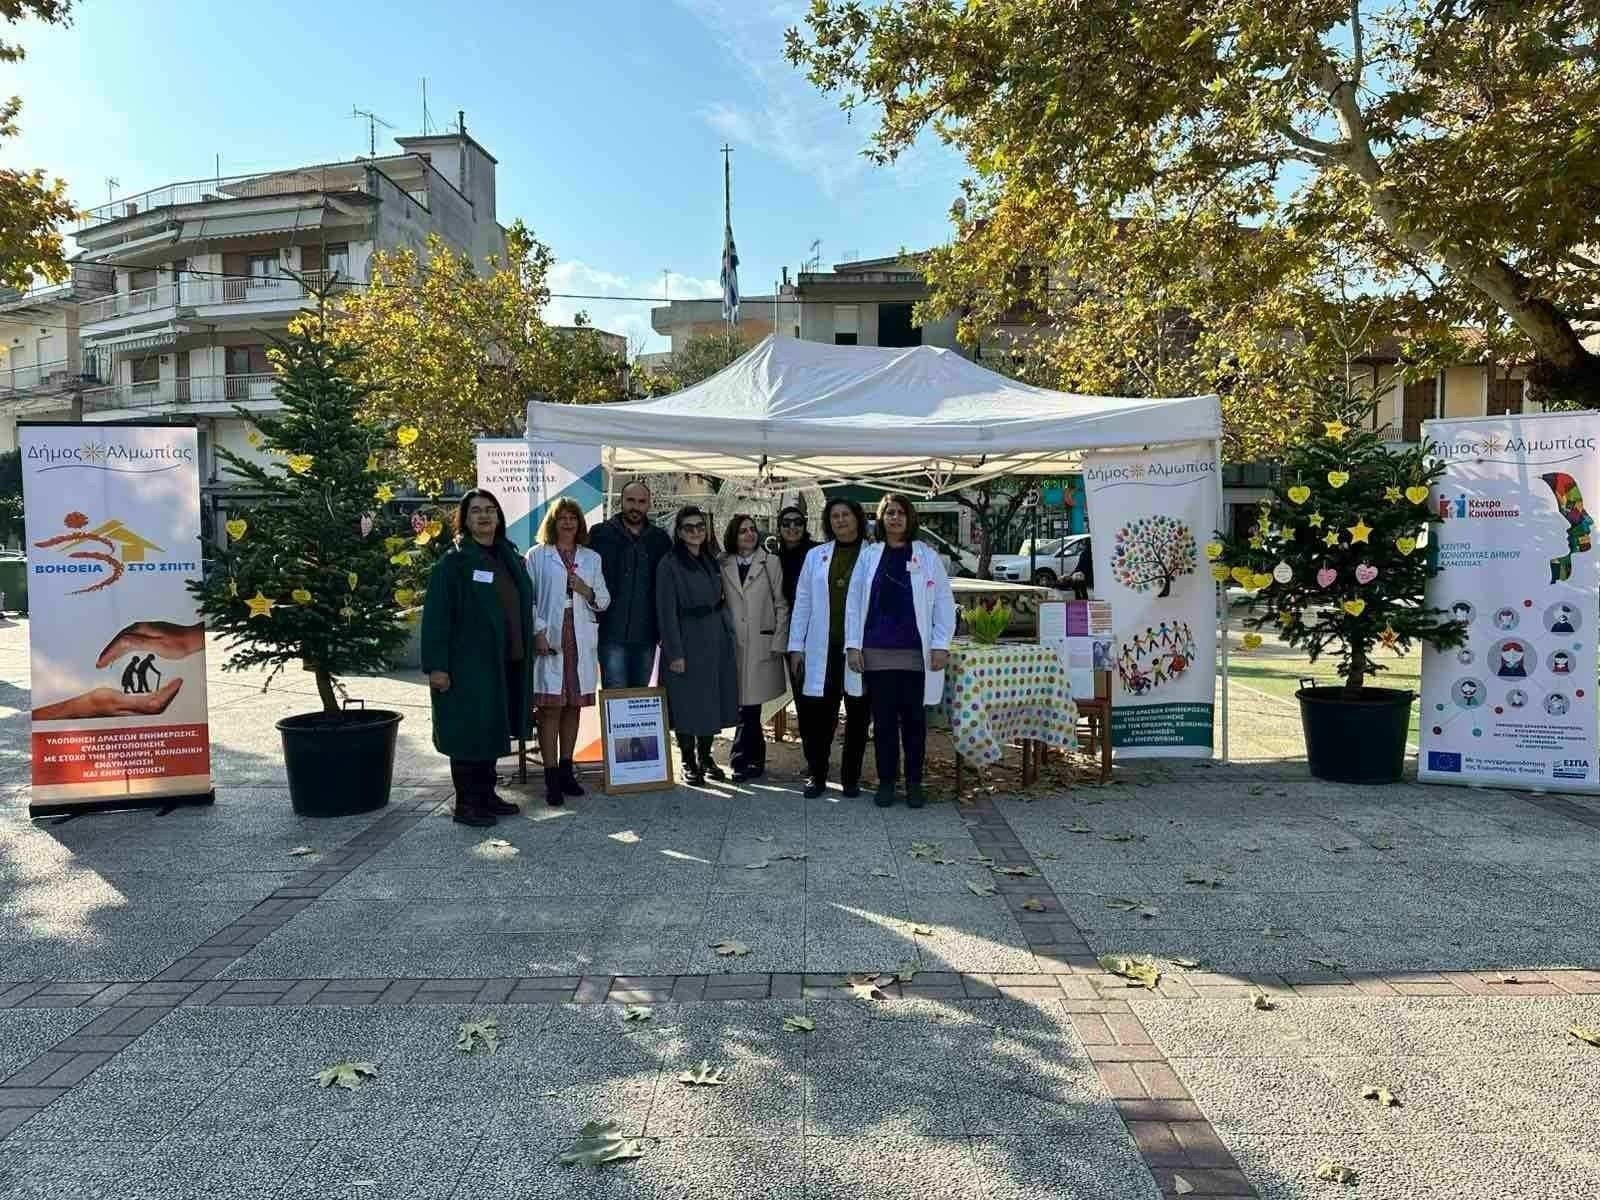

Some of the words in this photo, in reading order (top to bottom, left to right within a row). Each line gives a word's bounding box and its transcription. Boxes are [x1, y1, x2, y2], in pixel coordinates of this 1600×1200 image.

[1504, 434, 1597, 454] Αλμωπίας
[27, 443, 83, 462] Δήμος
[105, 443, 193, 462] Αλμωπίας
[485, 475, 522, 483] ΚΕΝΤΡΟ
[1468, 498, 1501, 509] Κέντρο
[1468, 509, 1520, 518] Κοινότητας
[34, 563, 103, 574] ΒΟΗΘΕΙΑ
[127, 563, 156, 572] ΣΤΟ
[159, 562, 196, 571] ΣΠΙΤΙ
[47, 735, 96, 745] ΥΛΟΠΟΙΗΣΗ
[97, 733, 137, 743] ΔΡΑΣΕΩΝ
[44, 755, 57, 763] ΜΕ
[58, 754, 86, 762] ΣΤΟΧΟ
[89, 752, 106, 760] ΤΗΝ
[155, 747, 203, 756] ΚΟΙΝΩΝΙΚΗ
[94, 759, 154, 769] ΕΝΔΥΝΑΜΩΣΗ
[1563, 759, 1590, 767] ΕΣΠΑ
[83, 770, 98, 778] ΚΑΙ
[101, 766, 165, 777] ΕΝΕΡΓΟΠΟΙΗΣΗ
